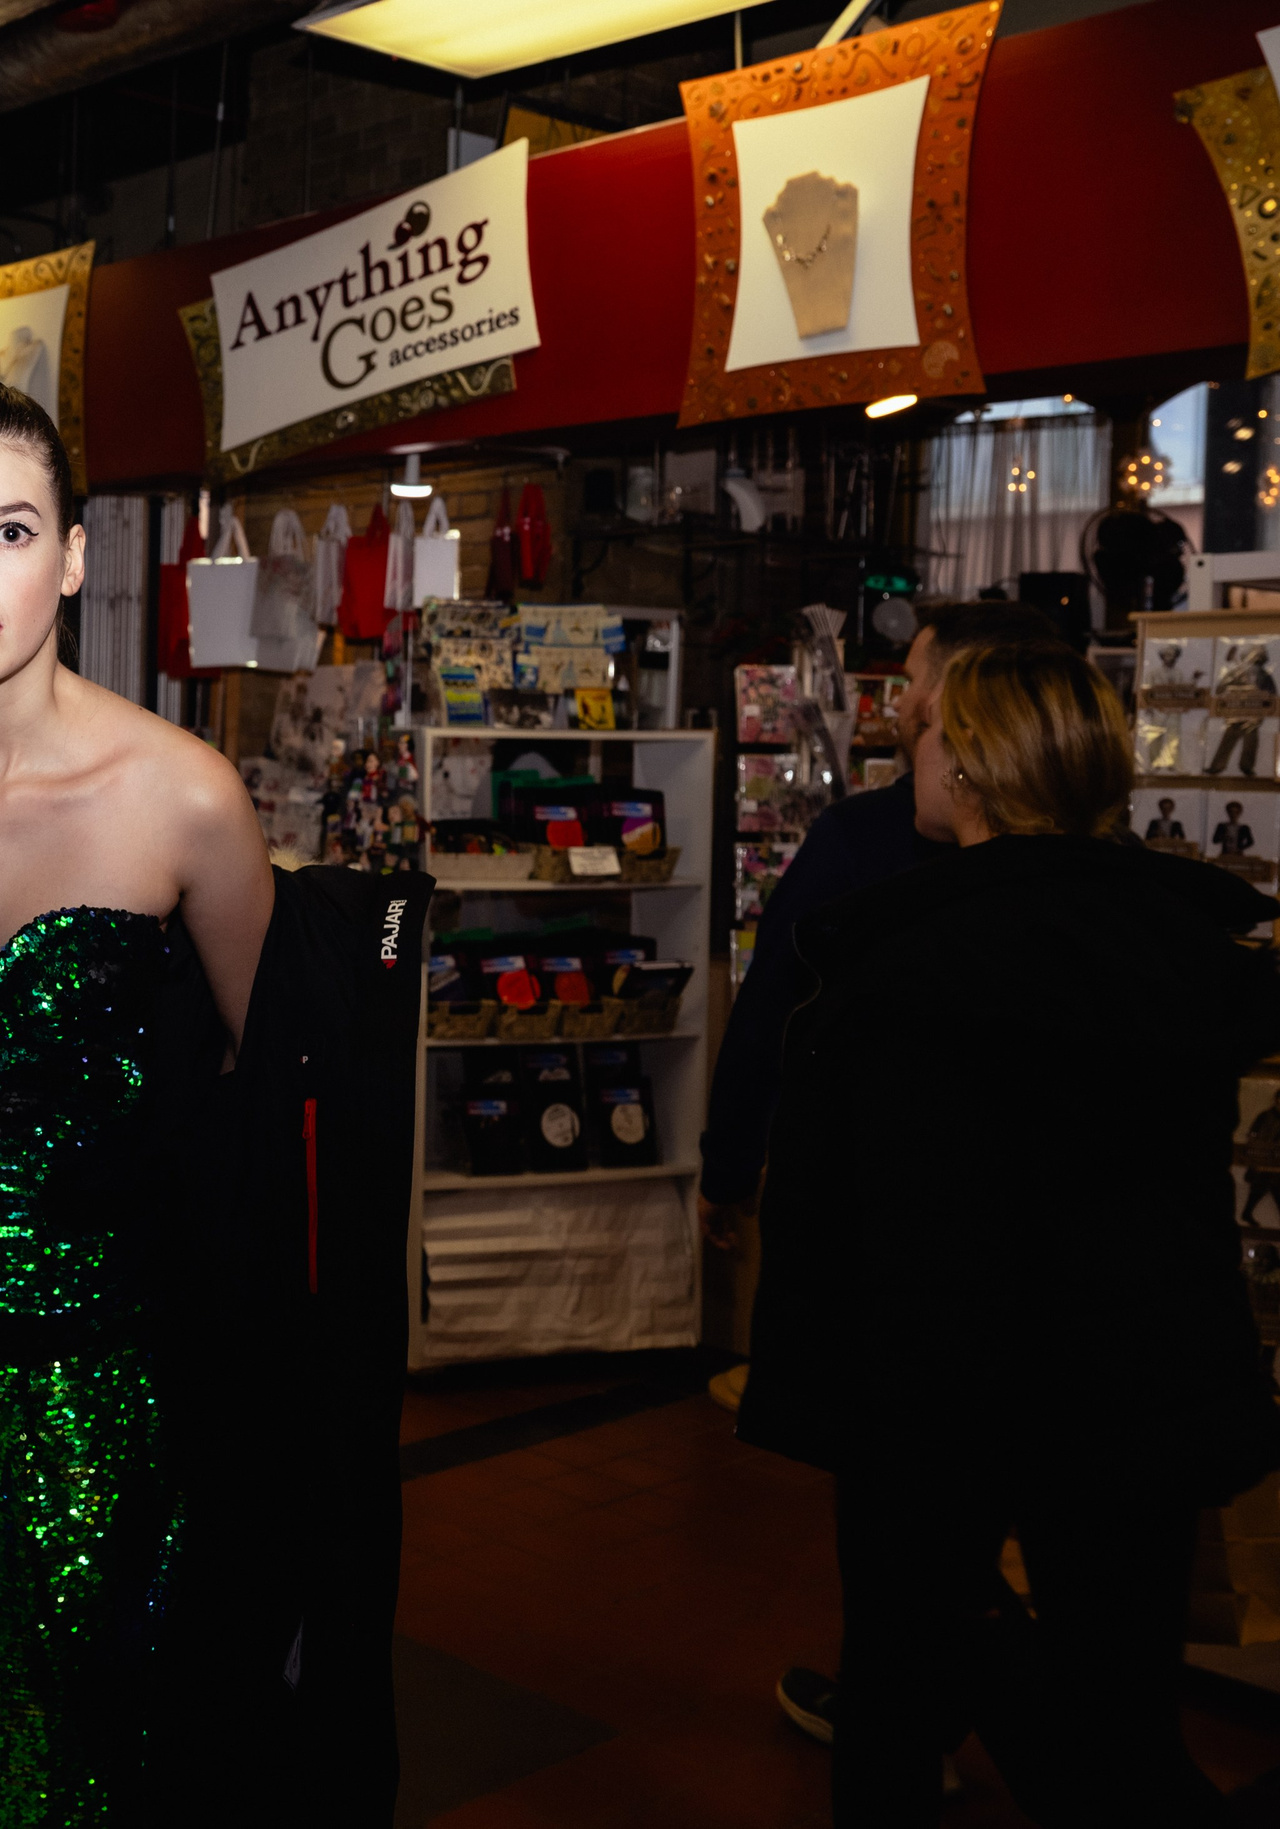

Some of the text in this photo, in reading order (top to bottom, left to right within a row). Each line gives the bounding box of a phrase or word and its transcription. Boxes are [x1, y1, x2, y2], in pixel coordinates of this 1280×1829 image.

[230, 219, 489, 350] Anything
[322, 286, 453, 389] Goes
[389, 307, 520, 367] accessories
